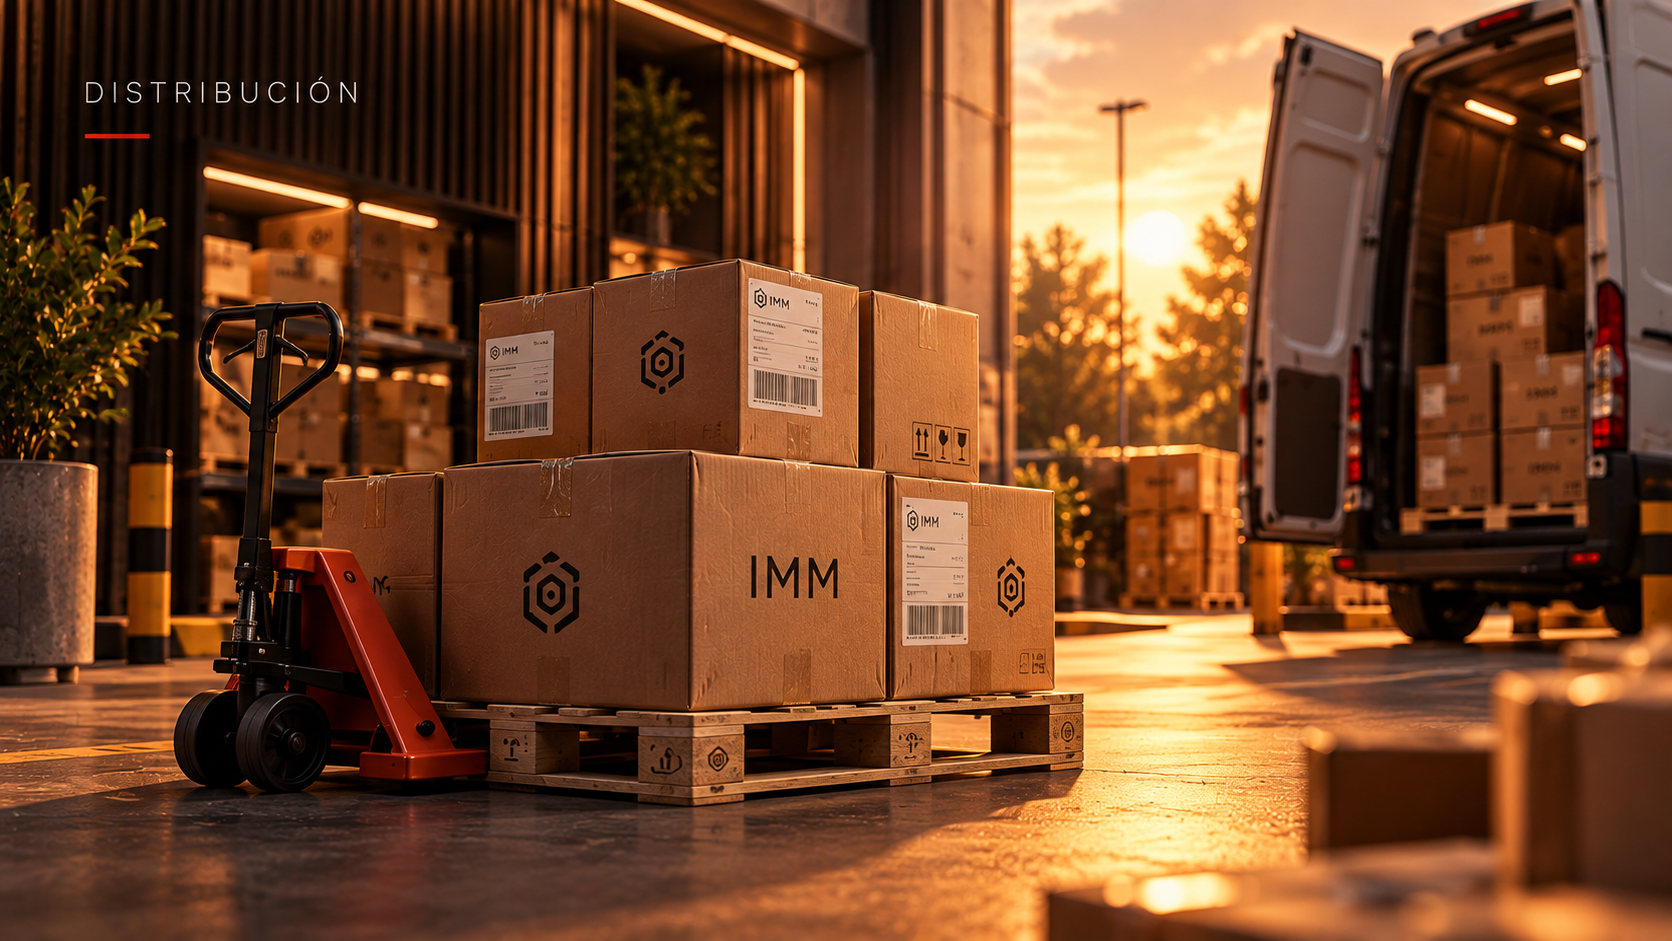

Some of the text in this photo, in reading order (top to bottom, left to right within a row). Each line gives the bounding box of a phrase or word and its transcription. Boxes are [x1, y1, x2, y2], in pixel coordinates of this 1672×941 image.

[769, 296, 790, 310] IMM
[920, 515, 940, 528] IMM
[750, 555, 840, 600] IMM
